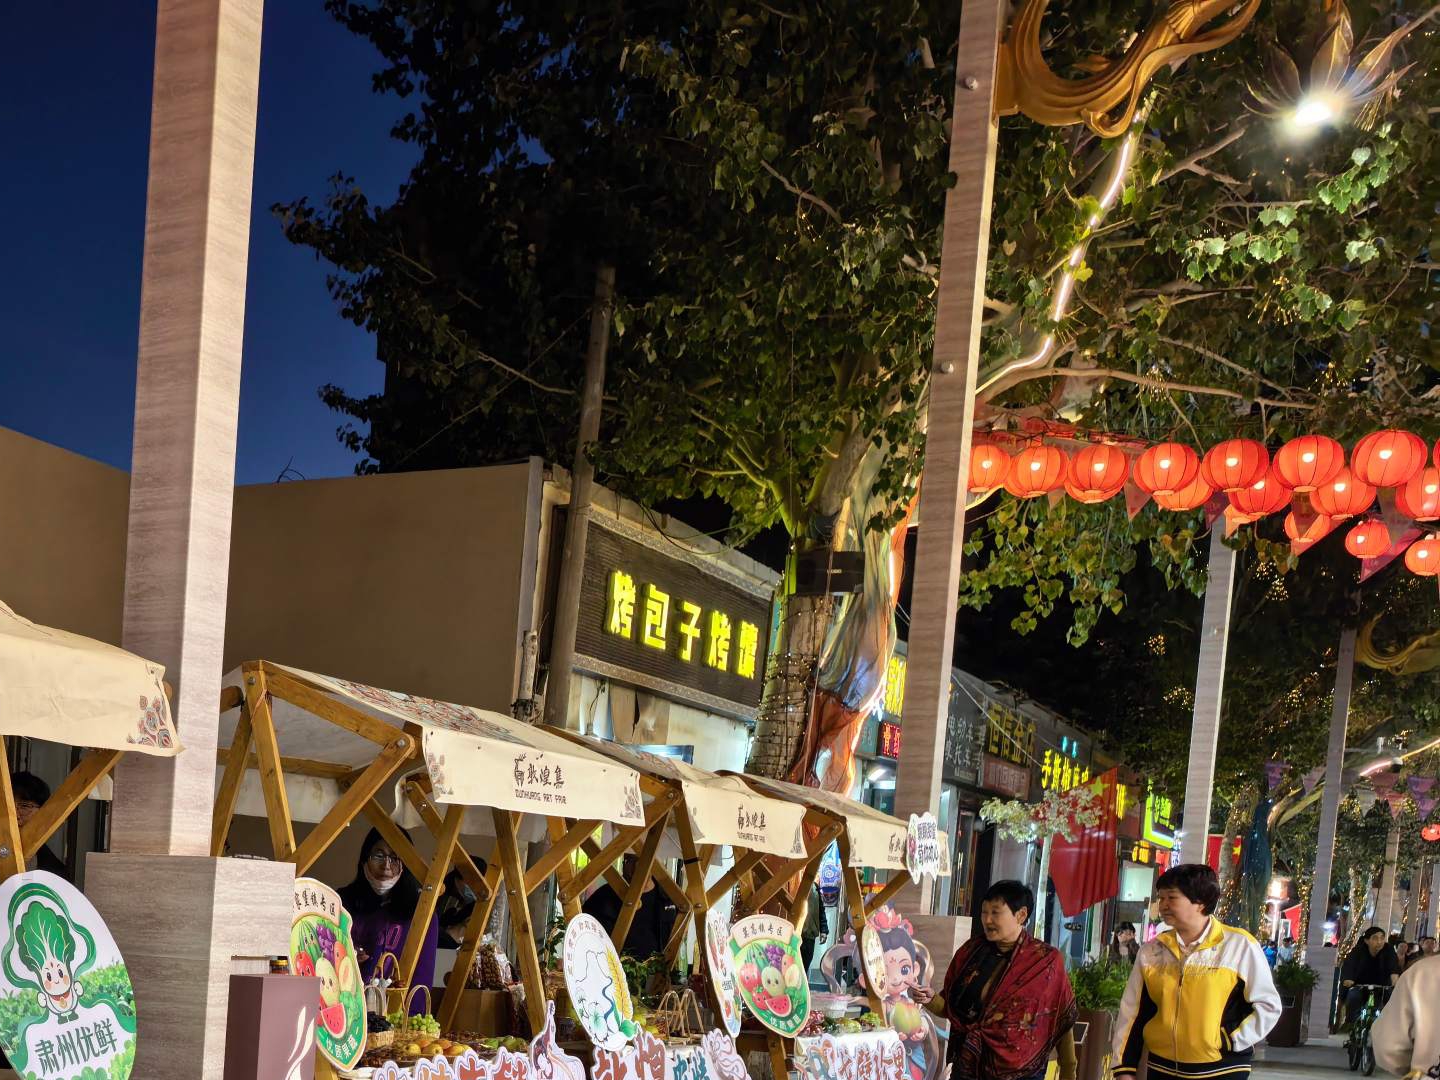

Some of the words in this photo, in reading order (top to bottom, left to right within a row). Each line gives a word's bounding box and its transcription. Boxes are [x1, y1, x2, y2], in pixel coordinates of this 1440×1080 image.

[611, 571, 759, 679] 烤包子烤馕
[527, 763, 564, 788] 敦煌集
[35, 1018, 117, 1077] 肃州优鲜
